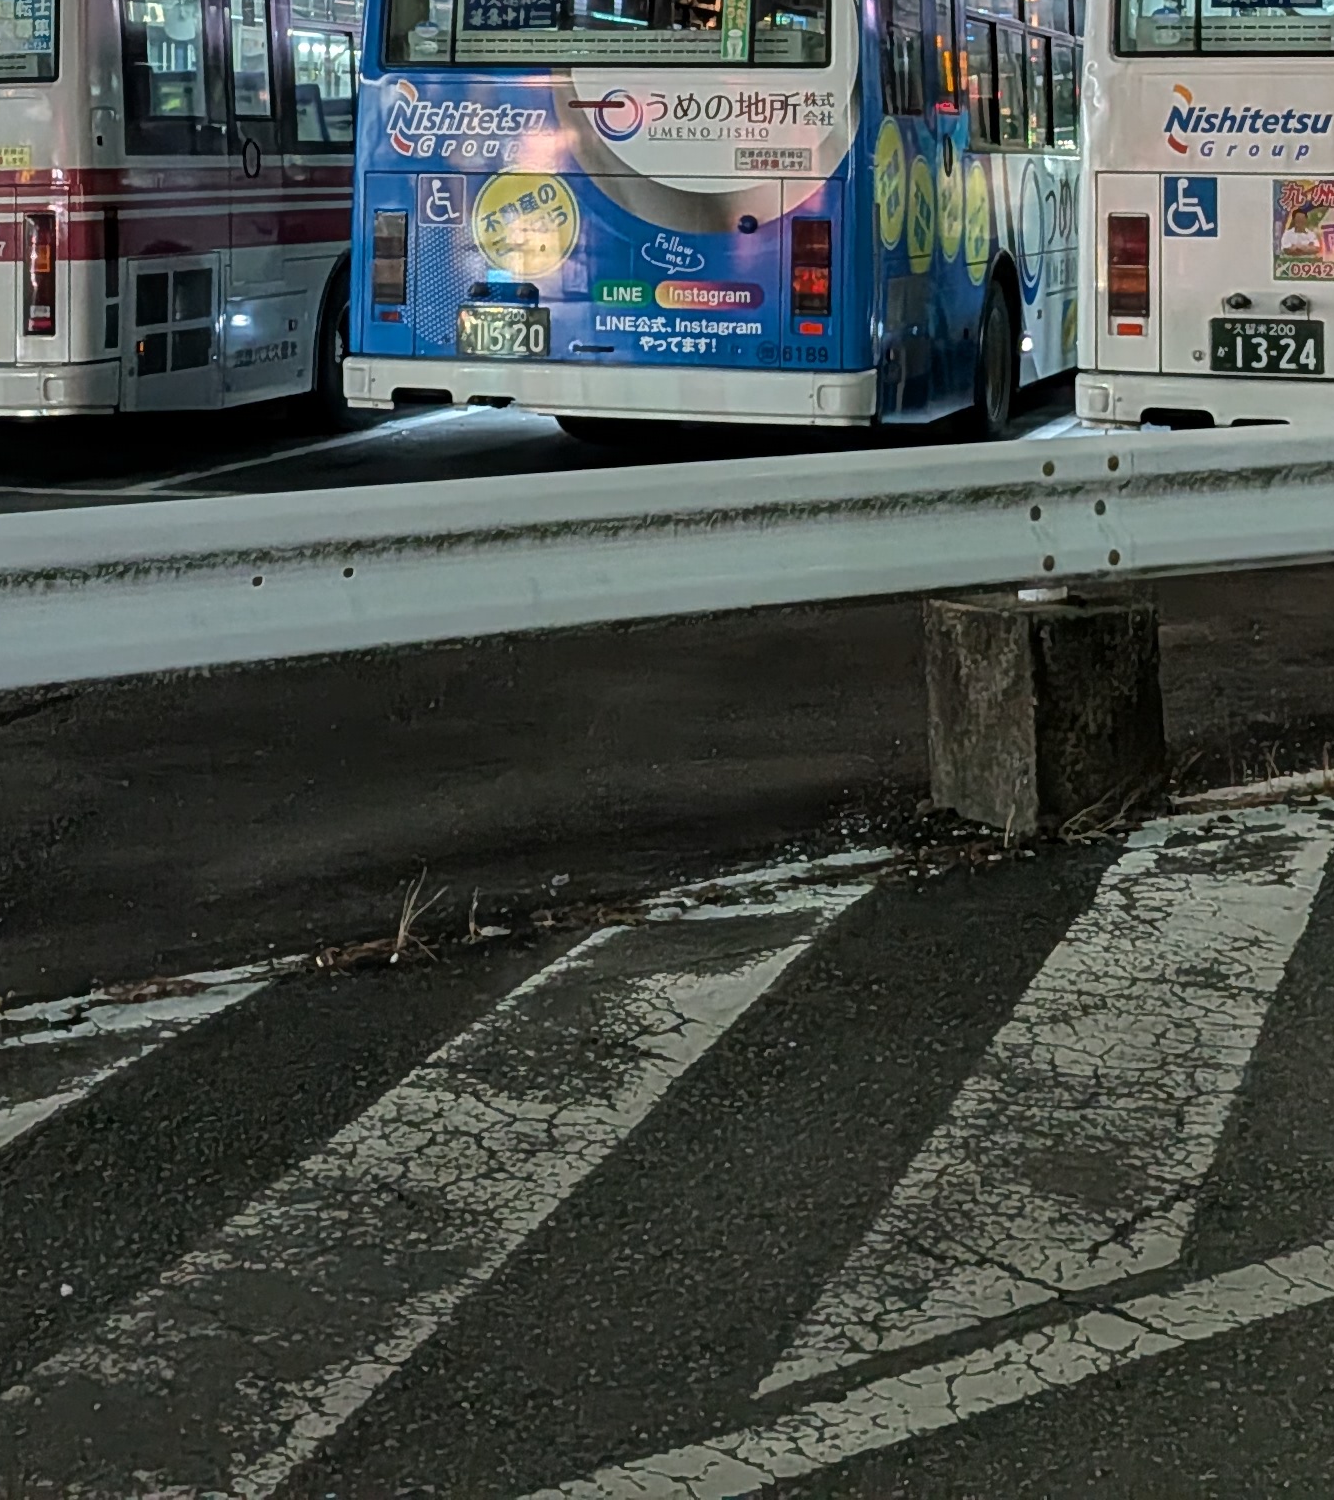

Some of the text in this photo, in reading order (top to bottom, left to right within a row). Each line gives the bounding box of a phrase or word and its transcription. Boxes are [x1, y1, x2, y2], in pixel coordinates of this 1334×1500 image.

[387, 99, 547, 134] Nishitetsu
[645, 91, 801, 125] うめの地所
[1164, 105, 1334, 134] Nishitetsu
[647, 127, 769, 139] UMENO JISHO
[418, 135, 522, 161] Group
[1199, 140, 1311, 160] Group
[654, 232, 694, 255] Follow
[602, 286, 751, 305] LINE Instagram
[639, 337, 717, 353] やってます!
[1235, 335, 1317, 371] 13-24
